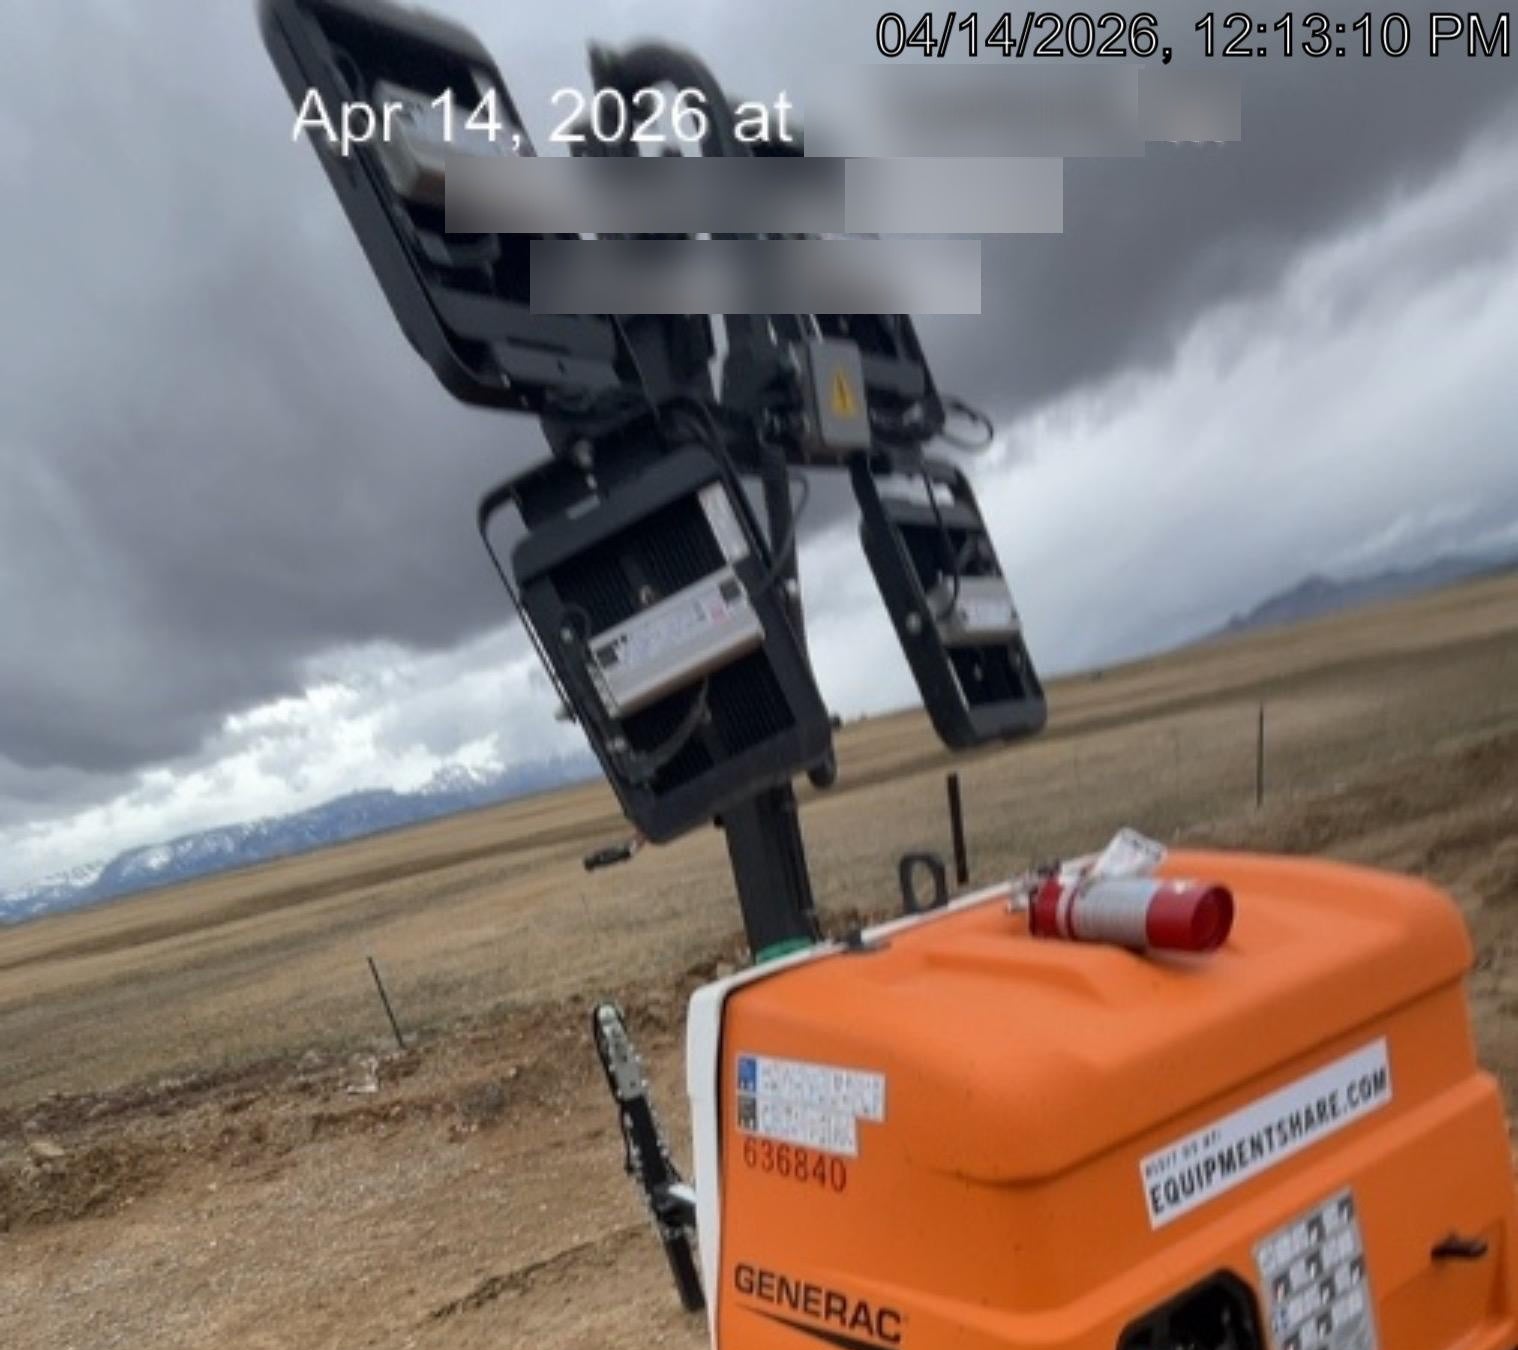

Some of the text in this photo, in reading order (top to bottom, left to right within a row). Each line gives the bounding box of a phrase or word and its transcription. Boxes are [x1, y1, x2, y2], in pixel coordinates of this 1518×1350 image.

[744, 1137, 847, 1192] 636840
[1150, 1067, 1387, 1215] EQUIPMENTSHARE.COM
[734, 1262, 901, 1344] GENERAC
